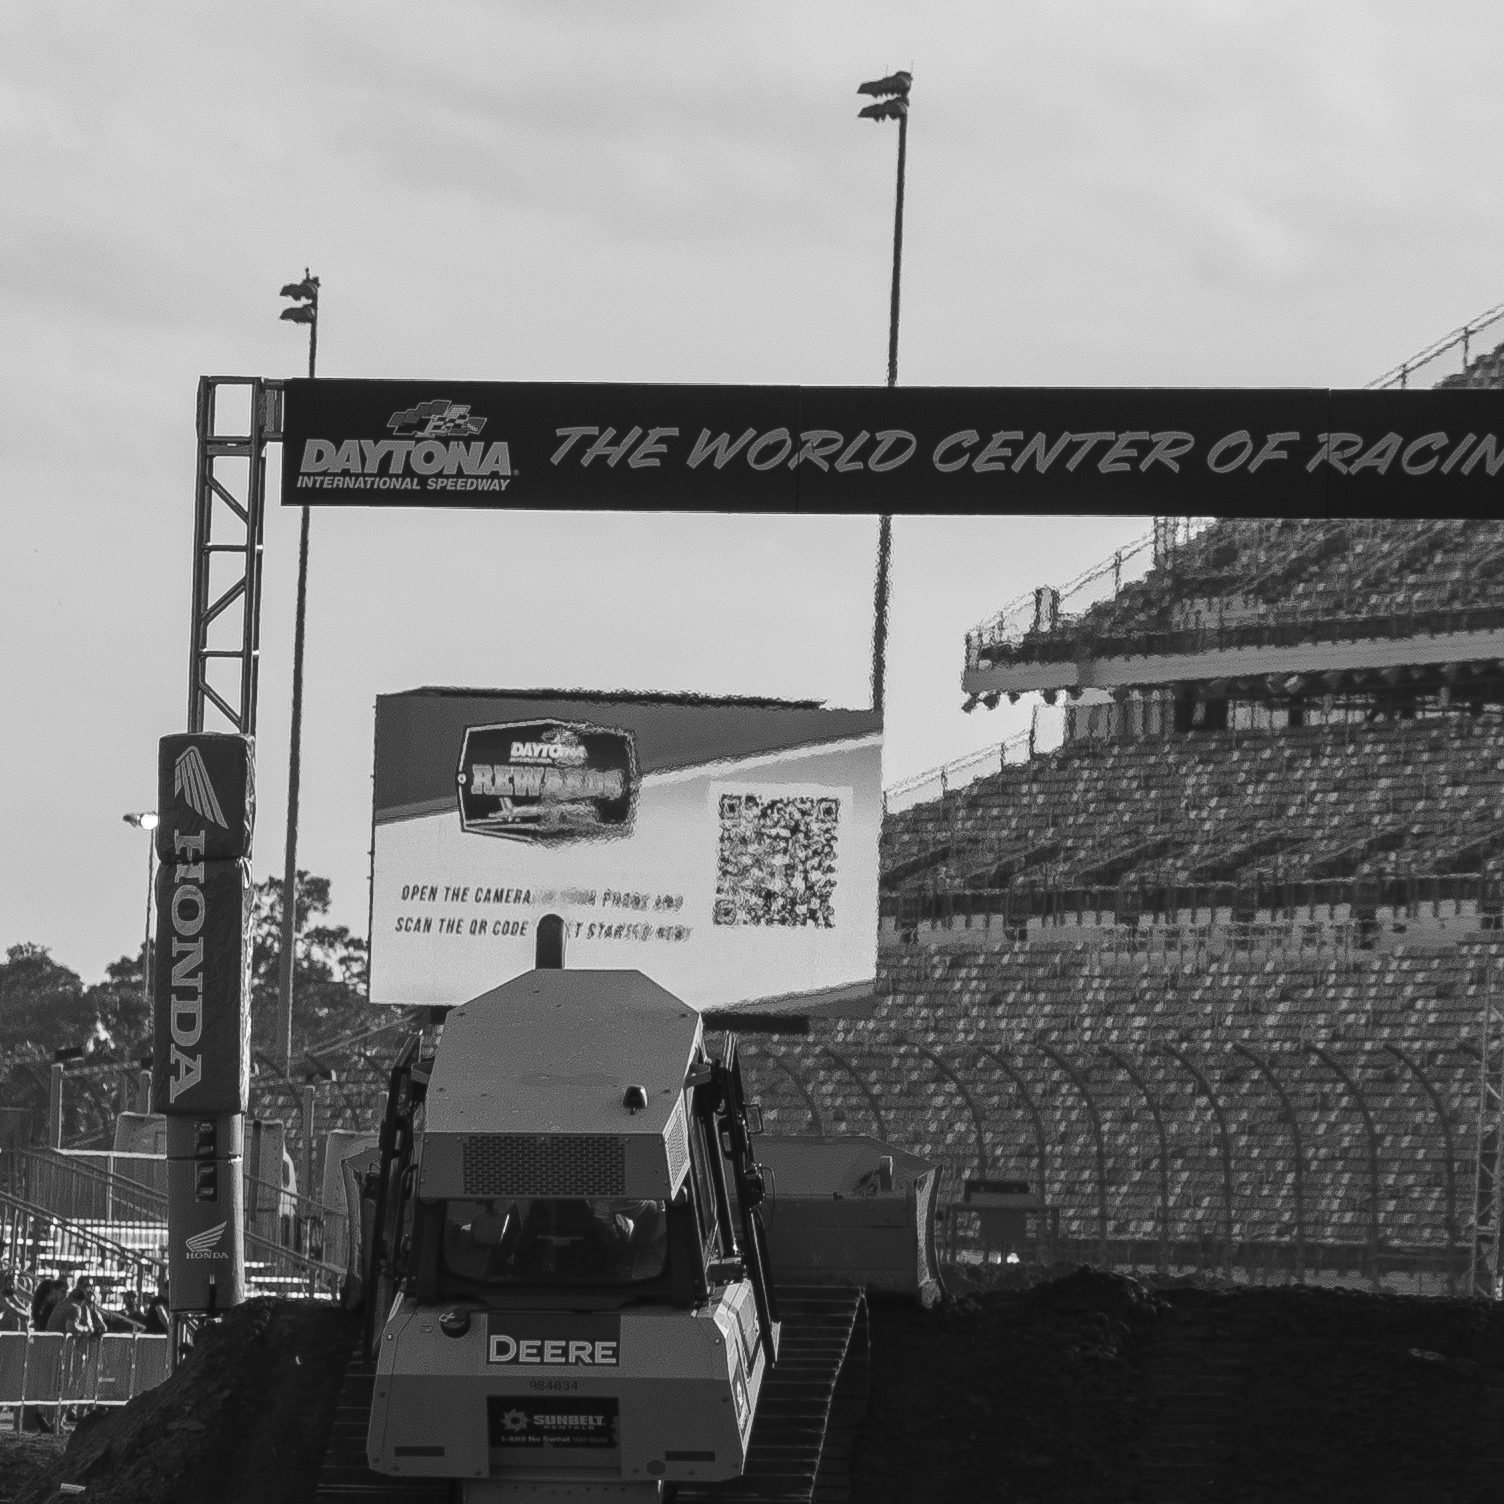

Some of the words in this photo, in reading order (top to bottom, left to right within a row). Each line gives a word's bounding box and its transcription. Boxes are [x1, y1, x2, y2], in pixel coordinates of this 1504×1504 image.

[300, 439, 512, 476] DAYTONA
[550, 427, 679, 468] THE
[687, 428, 917, 473] WORLD
[932, 430, 1195, 475] CENTER
[1206, 430, 1300, 474] OF
[296, 475, 421, 491] INTERNATIONAL
[426, 476, 511, 491] SPEEDWAY
[400, 883, 438, 904] OPEN
[442, 884, 470, 904] THE
[474, 886, 531, 906] CAMERA
[394, 917, 433, 937] SCAN
[437, 918, 465, 938] THE
[468, 919, 489, 939] QR
[491, 920, 529, 940] CODE
[170, 829, 205, 1103] HONDA
[489, 1334, 617, 1364] DEERE
[529, 1379, 579, 1391] 984634
[533, 1415, 605, 1426] SUNBELT
